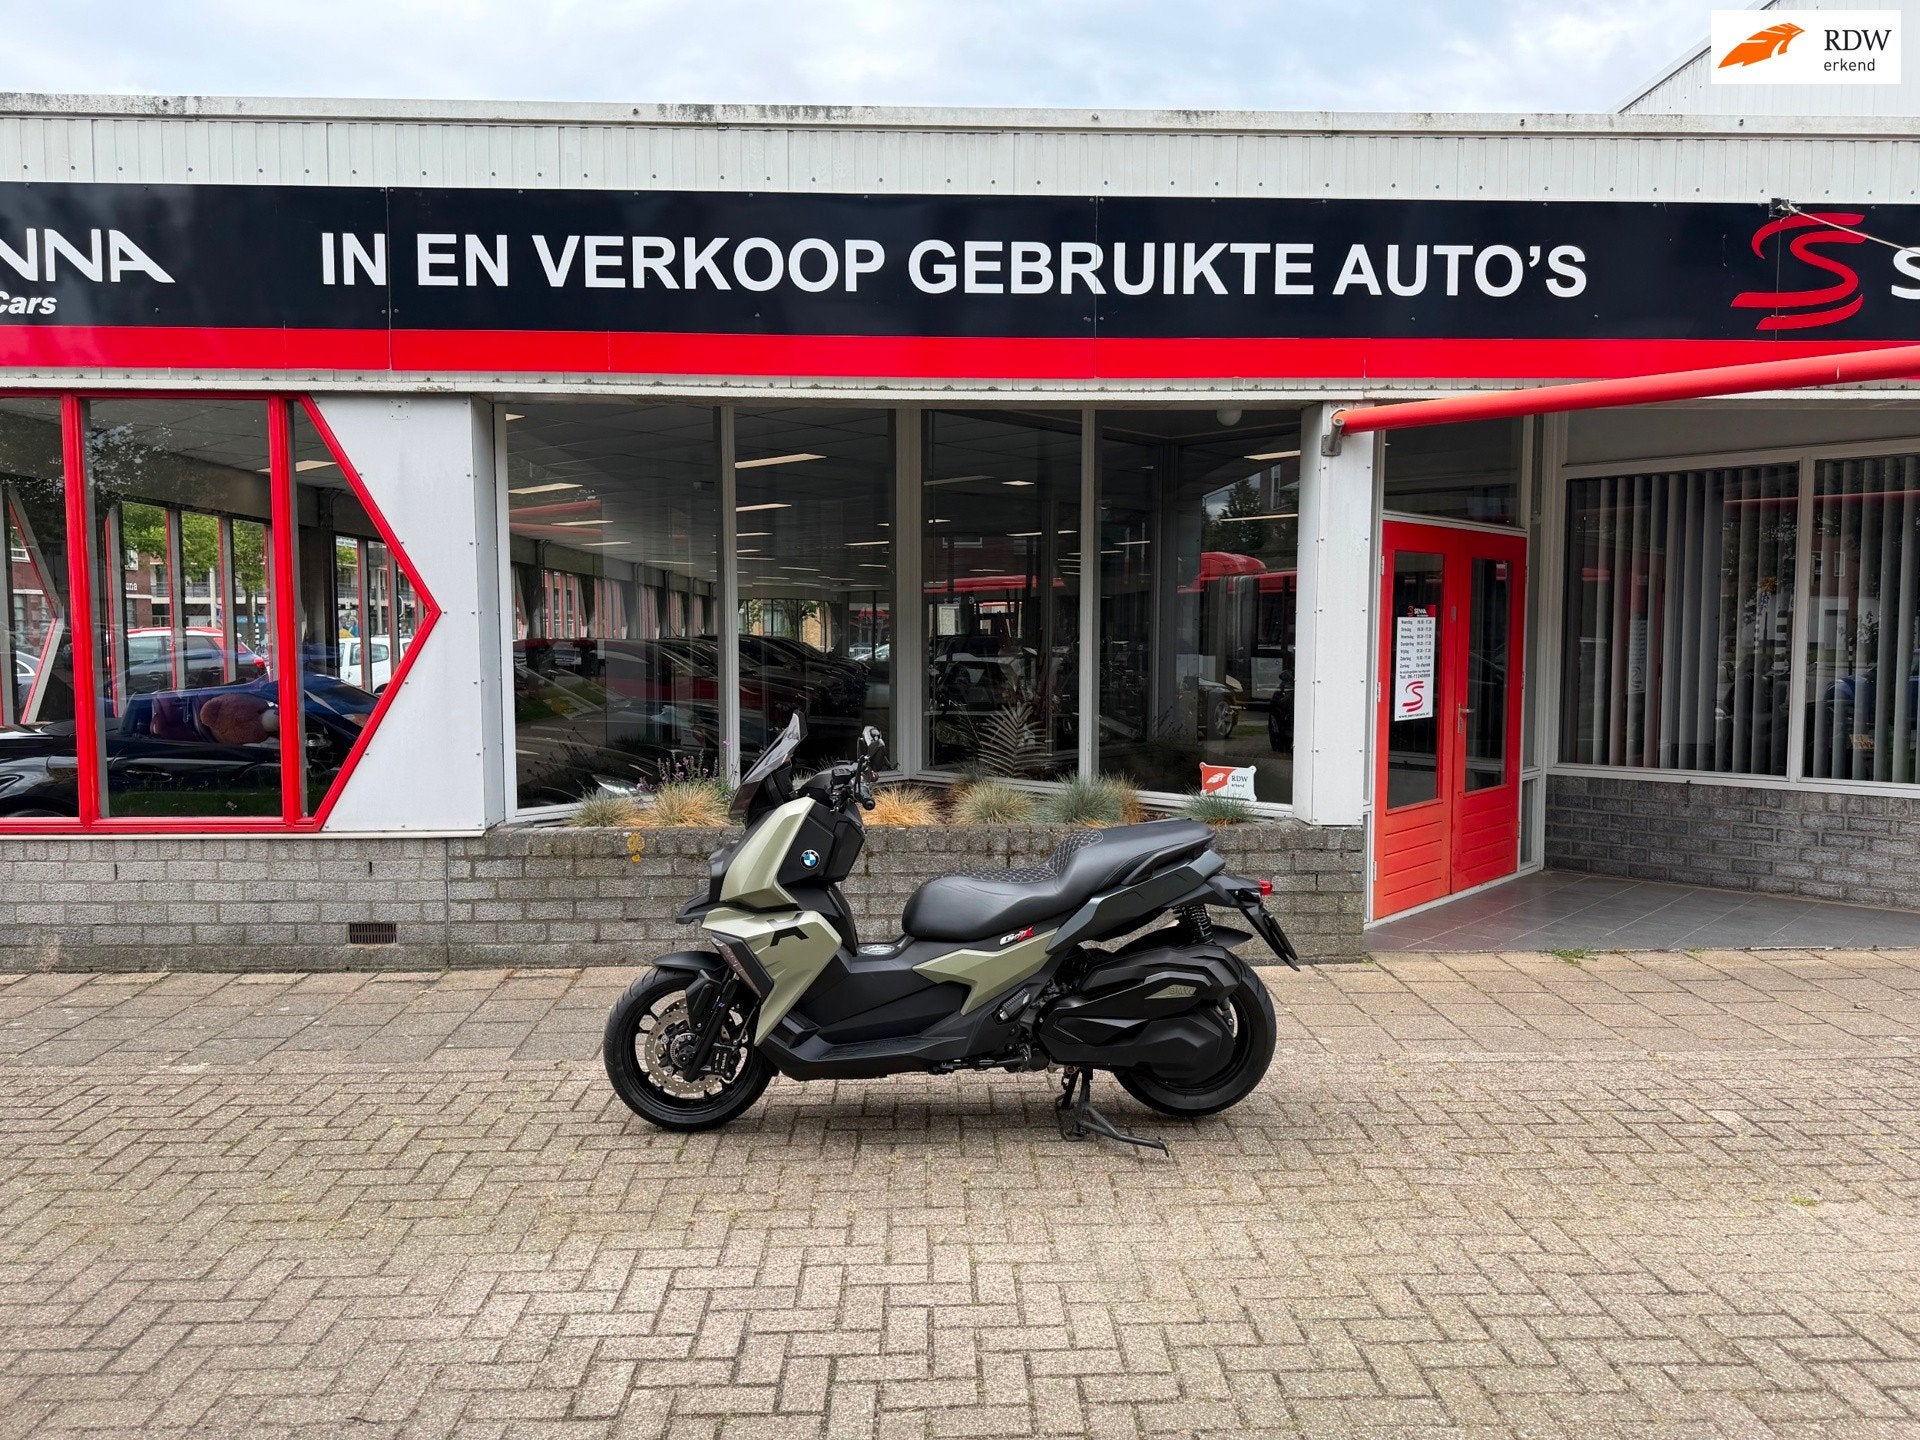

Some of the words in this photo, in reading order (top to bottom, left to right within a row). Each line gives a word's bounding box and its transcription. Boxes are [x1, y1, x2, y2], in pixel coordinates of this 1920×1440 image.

[322, 233, 386, 286] IN
[417, 234, 508, 287] EN
[532, 235, 884, 293] VERKOOP
[909, 240, 1313, 296] GEBRUIKTE
[1333, 244, 1586, 298] AUTO'S
